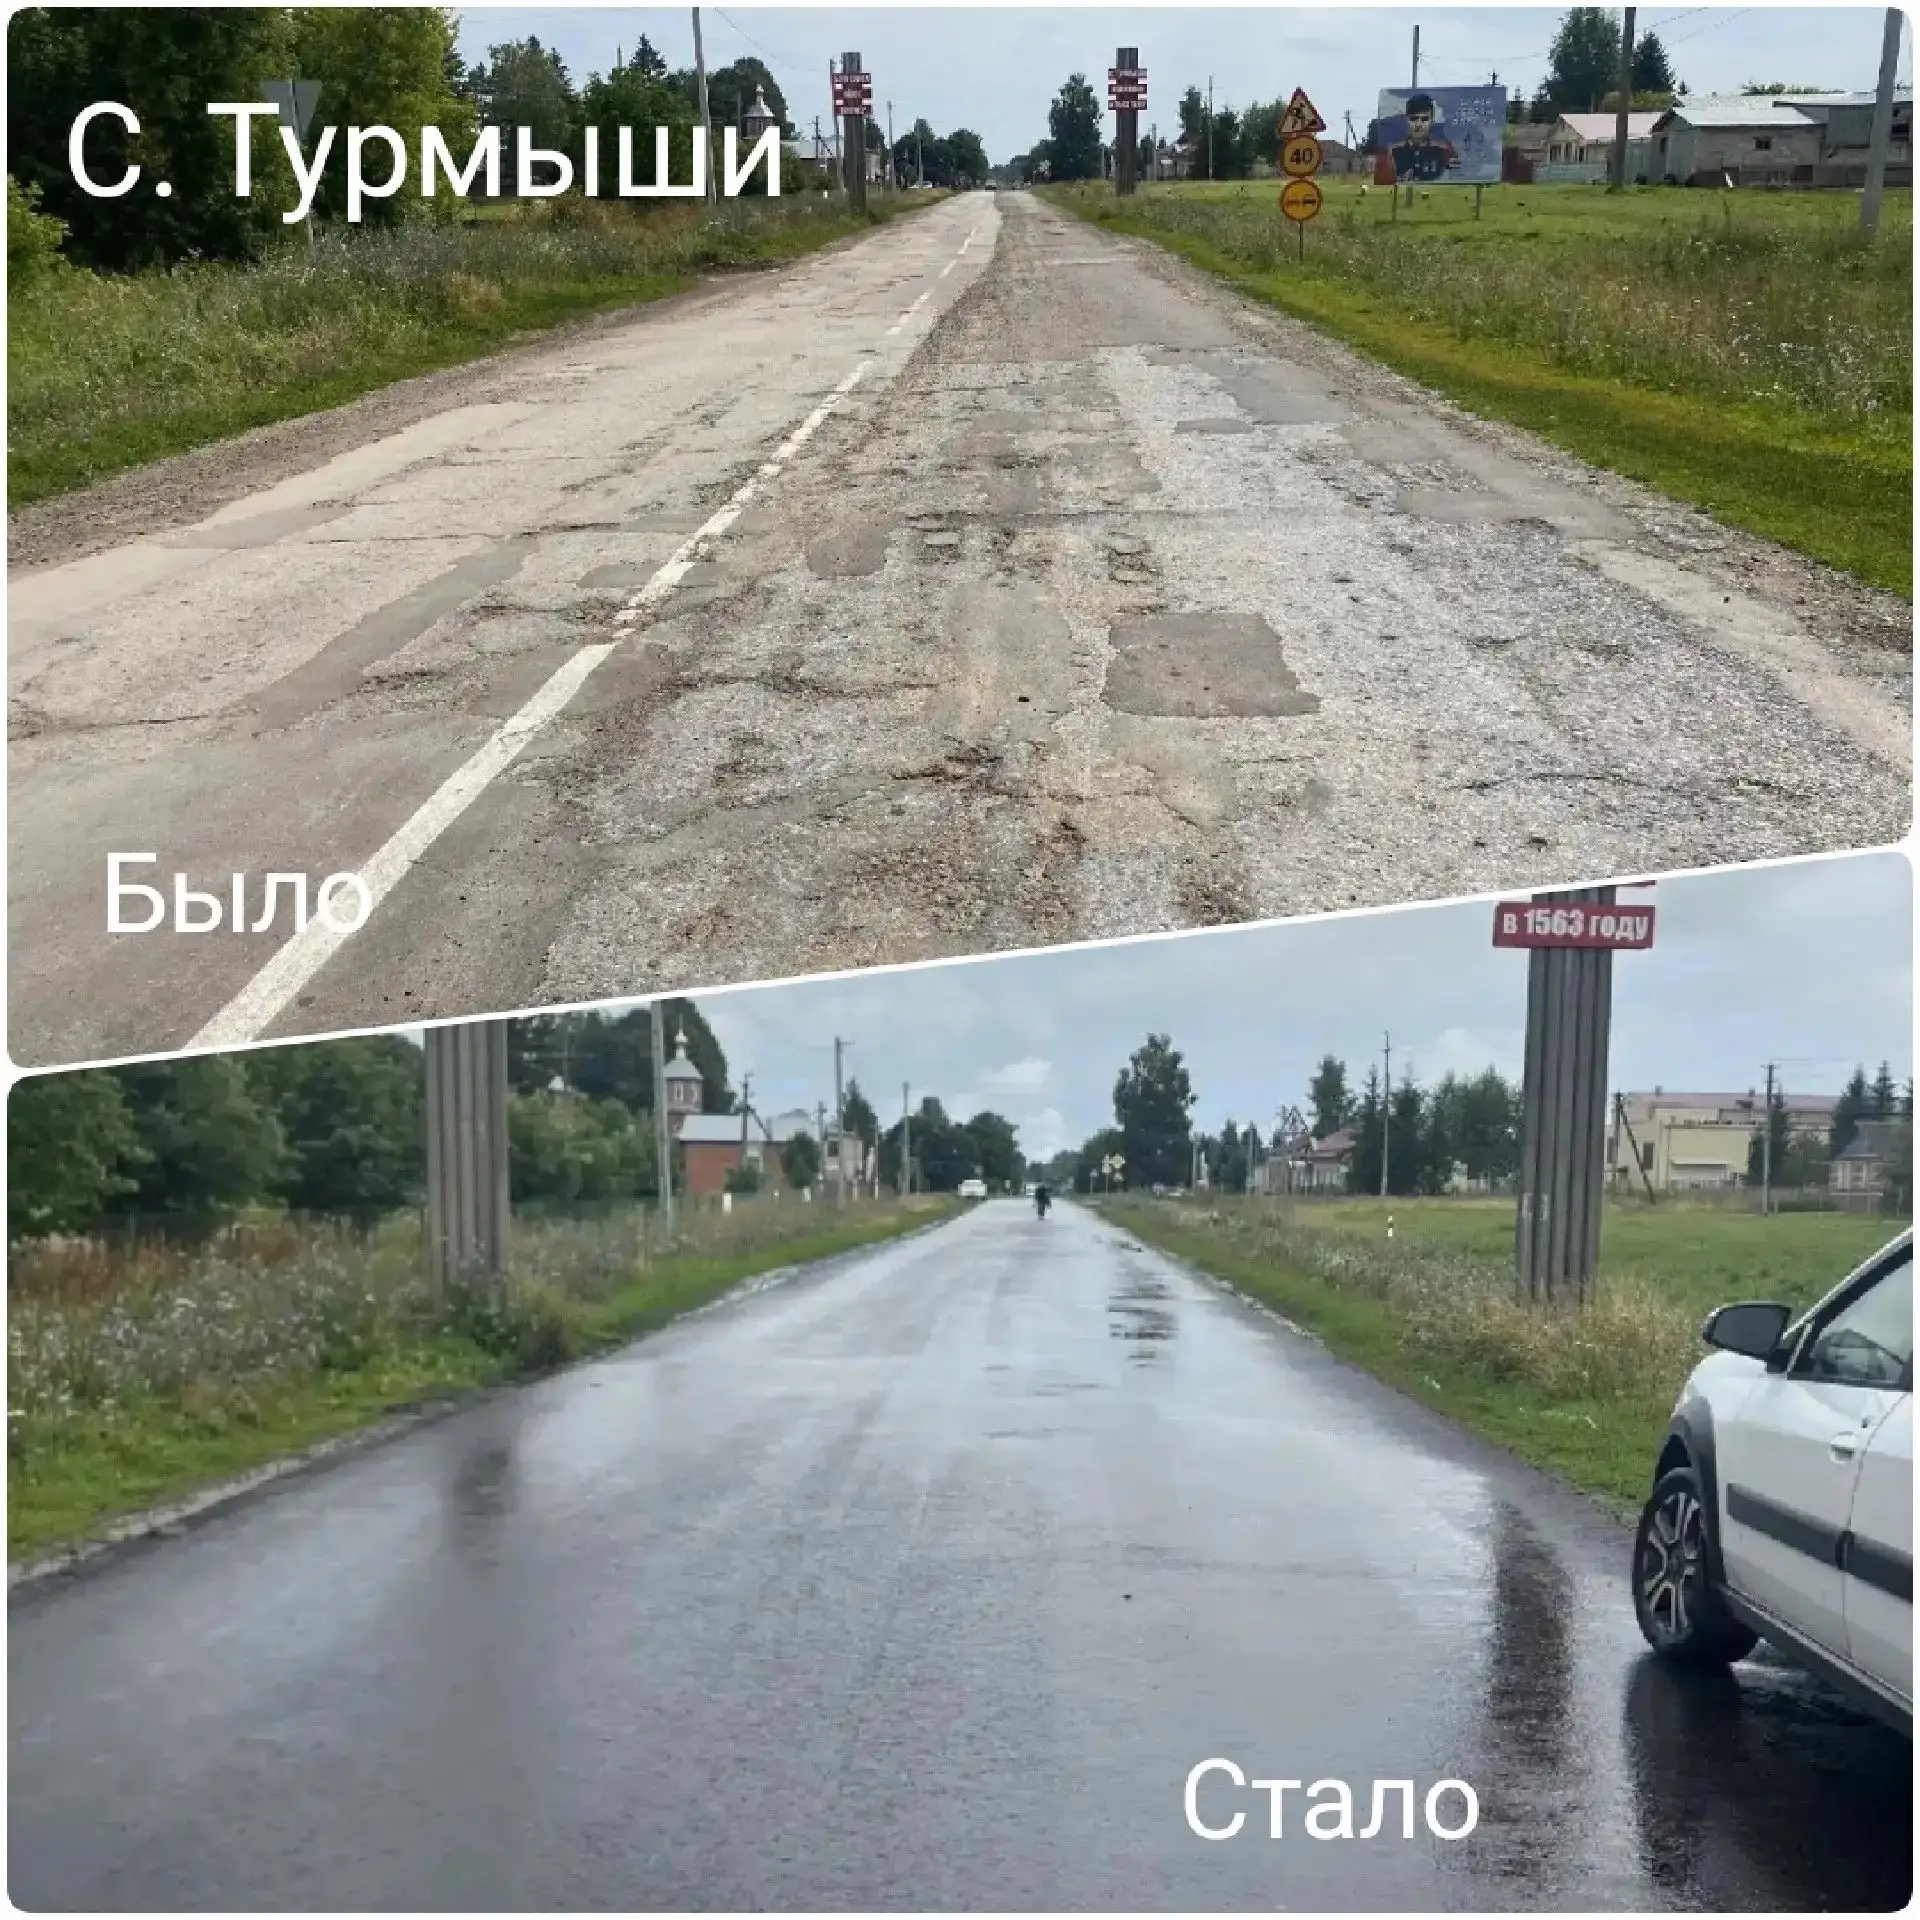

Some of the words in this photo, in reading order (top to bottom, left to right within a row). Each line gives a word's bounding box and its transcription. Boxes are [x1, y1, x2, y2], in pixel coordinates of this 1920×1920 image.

[1290, 148, 1313, 164] 40
[1524, 908, 1584, 937] 1563
[1589, 915, 1649, 941] году
